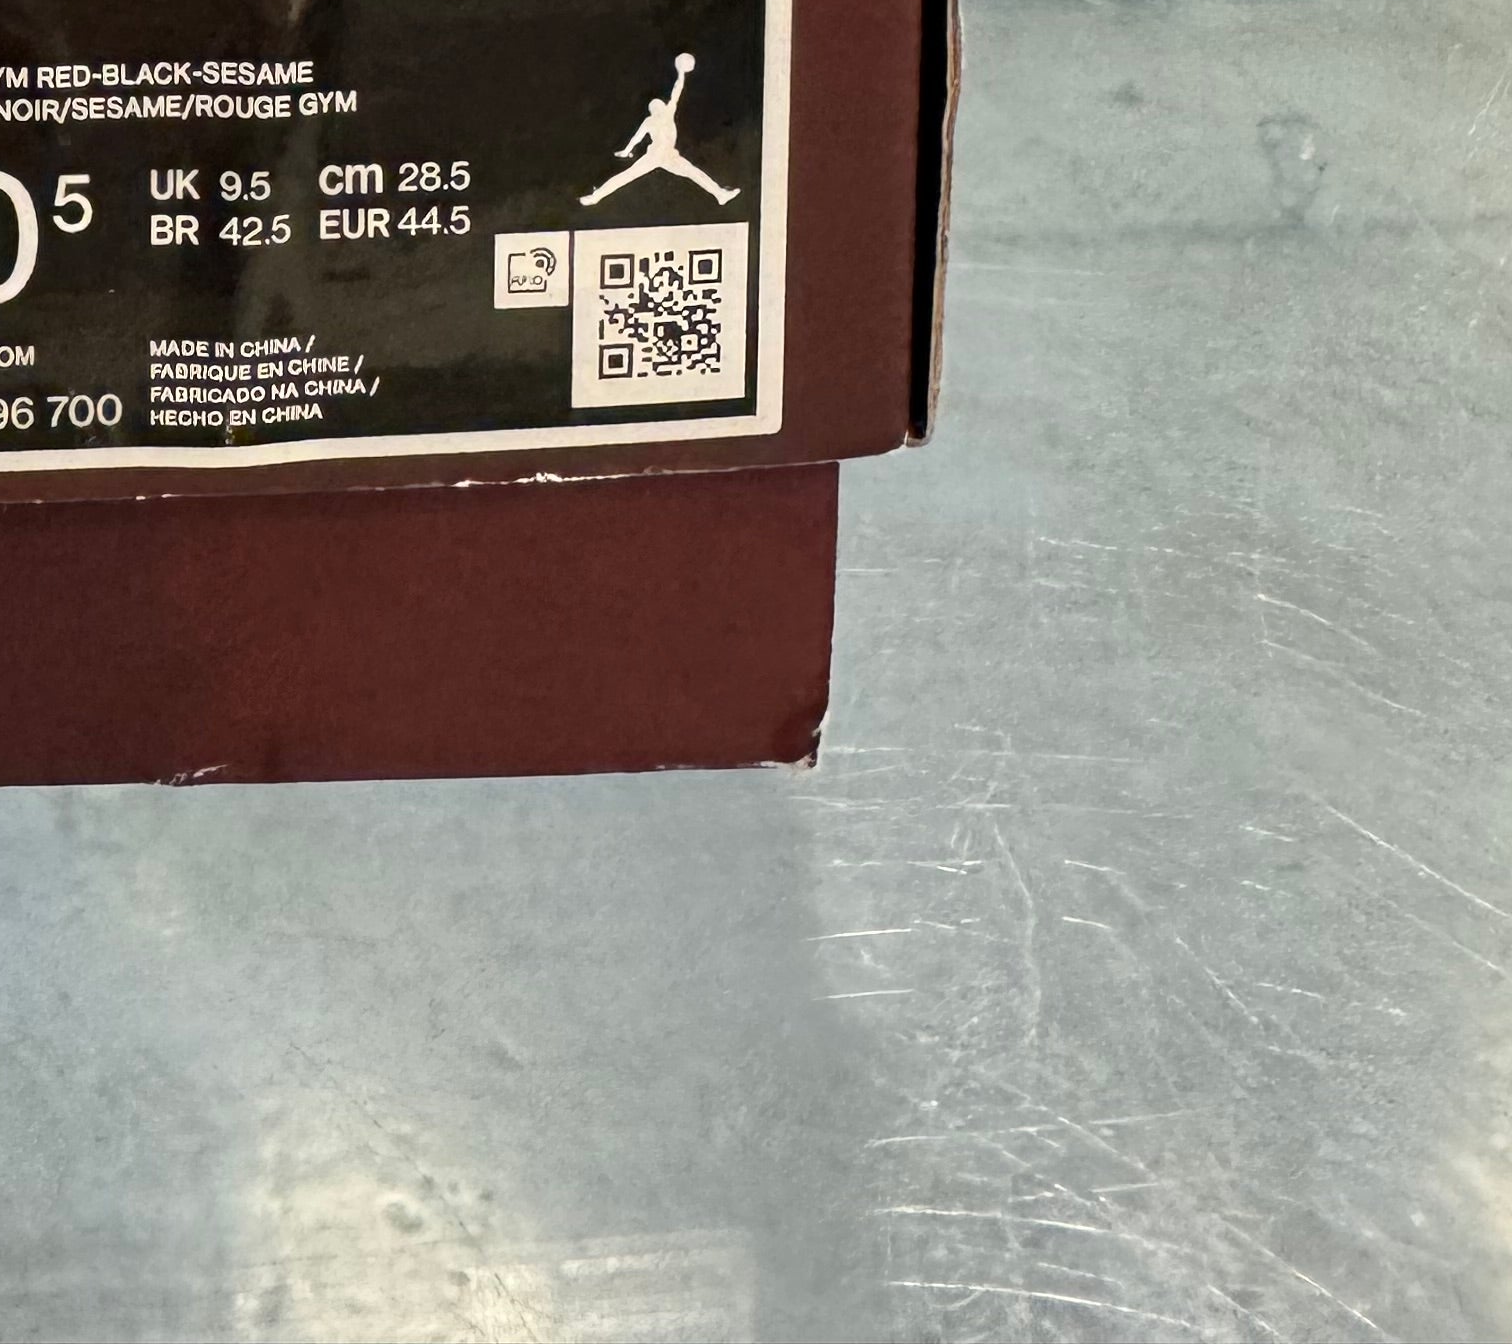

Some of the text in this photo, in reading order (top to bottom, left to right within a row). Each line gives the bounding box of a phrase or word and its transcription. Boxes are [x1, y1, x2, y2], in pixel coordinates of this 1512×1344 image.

[37, 61, 313, 88] RED-BLACK-SESAME
[299, 90, 356, 115] GYM
[151, 161, 470, 201] UK 9.5 cm 28.5
[151, 206, 470, 246] BR 42.5 EUR 44.5
[150, 340, 209, 357] MADE
[215, 342, 234, 358] IN
[151, 363, 251, 382] FABRIQUE
[257, 361, 283, 379] EN
[151, 386, 265, 404] FABRICADO
[272, 382, 299, 401] NA
[47, 394, 122, 427] 700
[151, 403, 323, 426] HECHO EN CHINA
